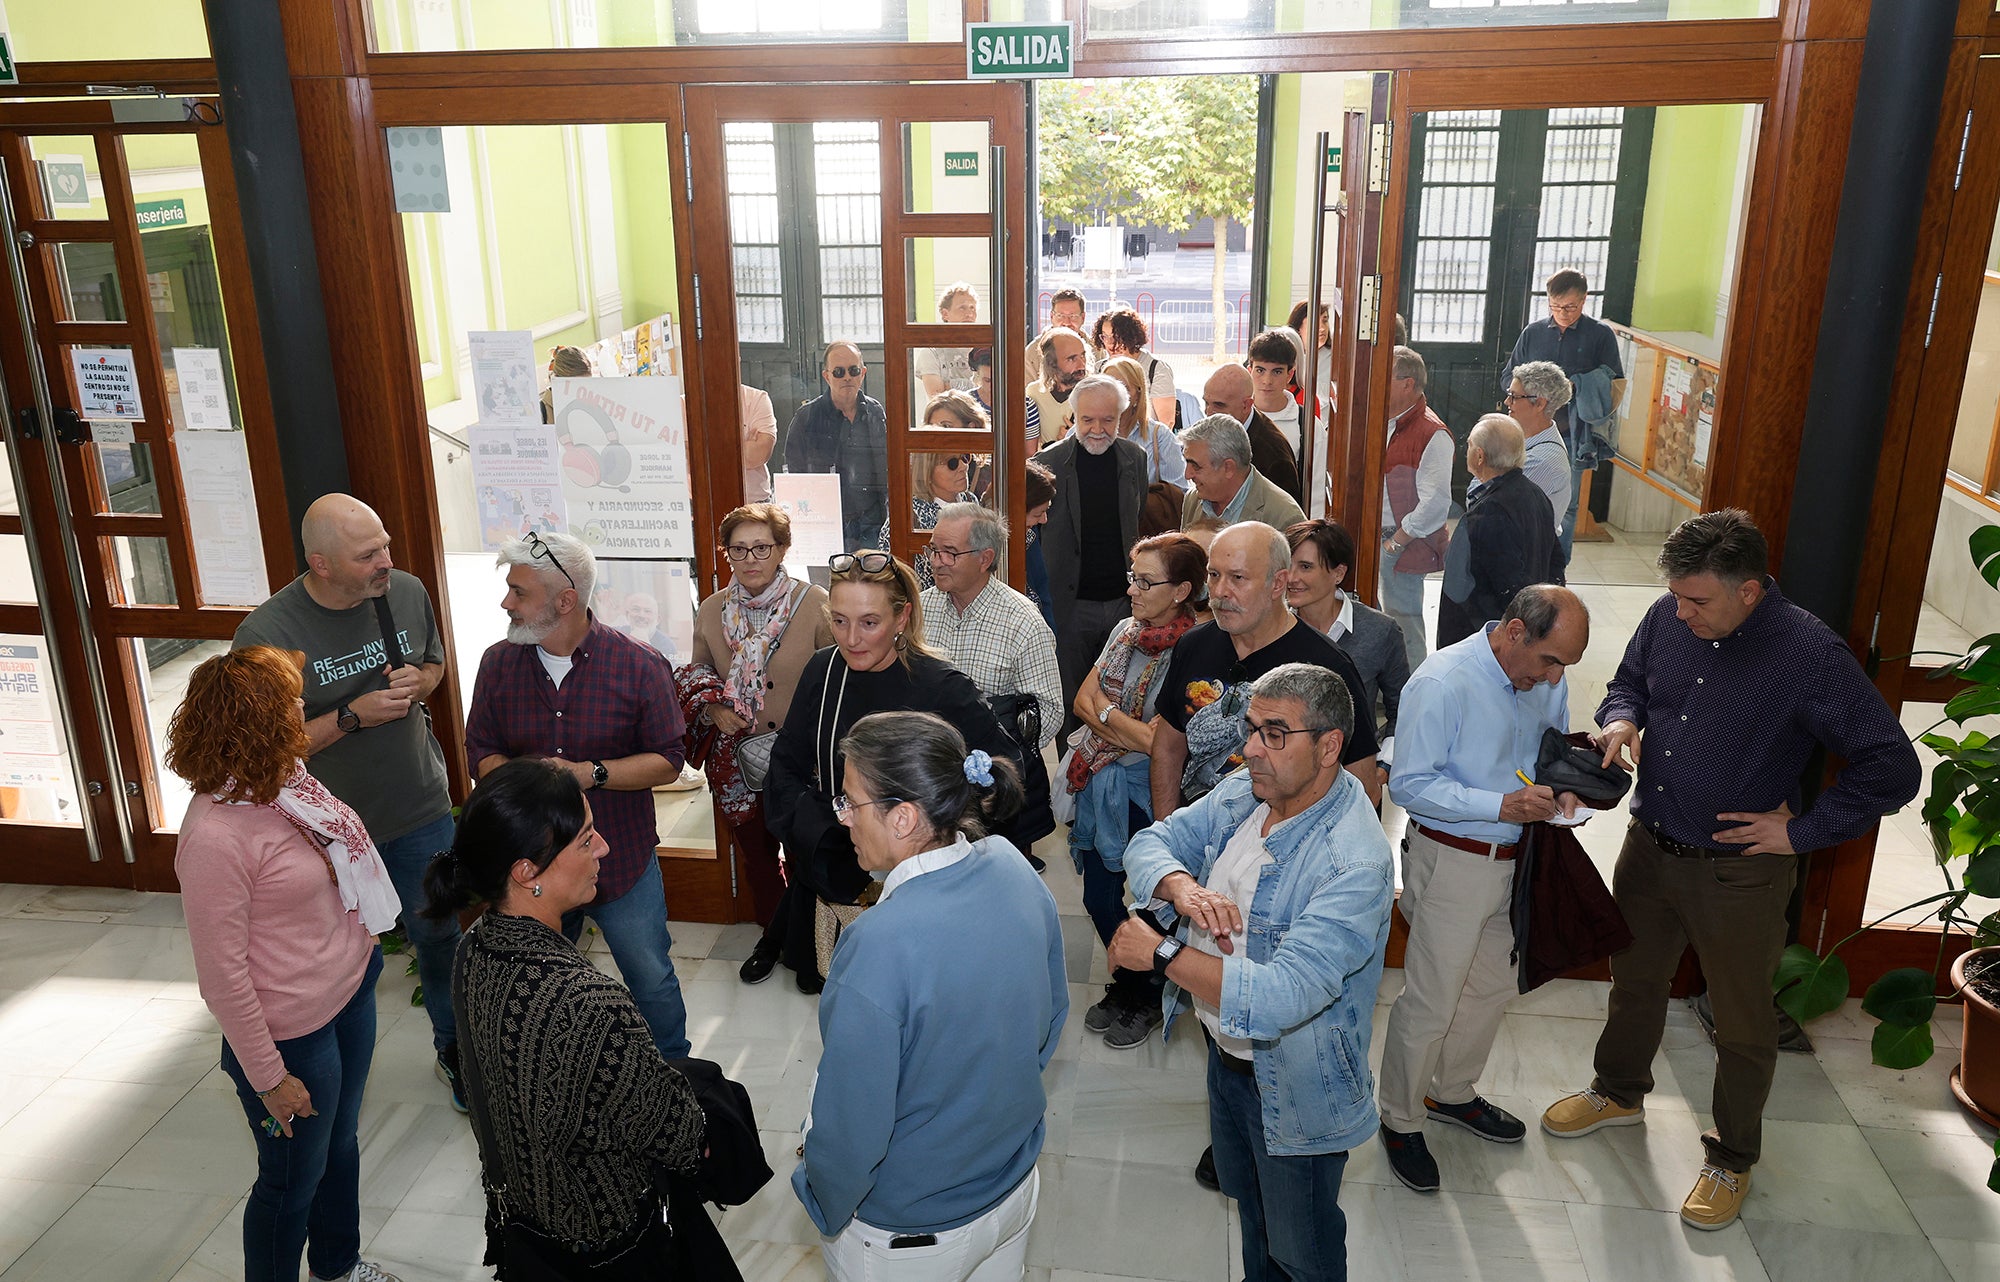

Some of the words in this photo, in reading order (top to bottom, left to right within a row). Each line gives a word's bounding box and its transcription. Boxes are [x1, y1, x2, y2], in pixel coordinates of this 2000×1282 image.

[977, 34, 1064, 66] SALIDA
[946, 158, 977, 170] SALIDA
[1328, 154, 1341, 166] LID
[136, 205, 184, 224] nserjería
[93, 373, 114, 381] SALIDA
[84, 382, 106, 390] CENTRO
[106, 383, 113, 391] SI
[93, 392, 122, 401] PRESENTA
